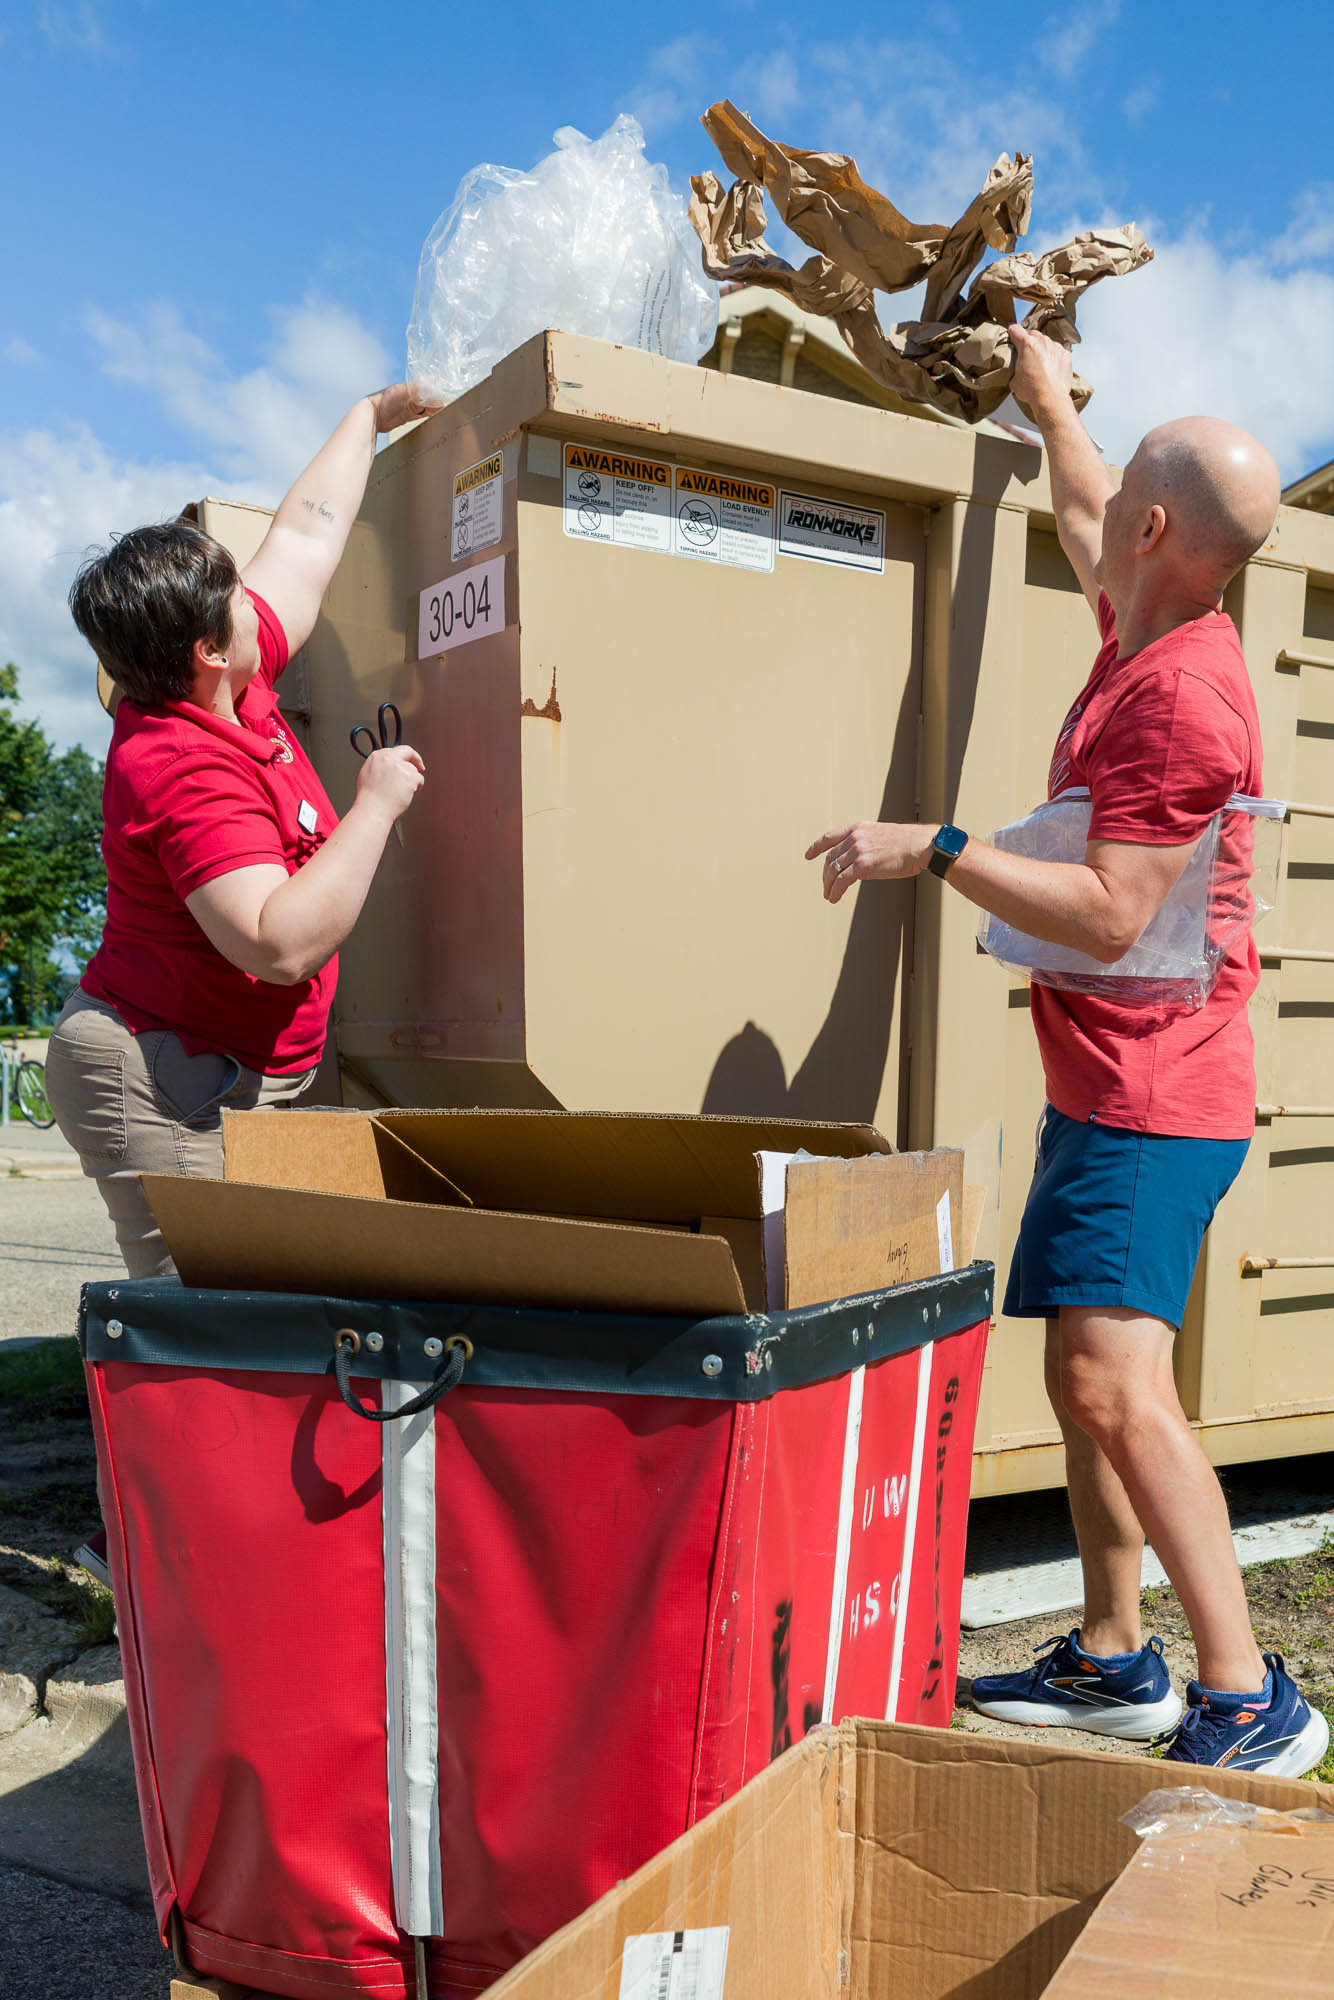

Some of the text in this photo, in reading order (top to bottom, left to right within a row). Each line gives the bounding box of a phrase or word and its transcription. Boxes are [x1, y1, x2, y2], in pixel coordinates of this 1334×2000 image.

[461, 457, 500, 494] WARNING
[583, 452, 667, 484] WARNING
[615, 479, 654, 493] KEEP OFF!
[693, 474, 770, 505] WARNING
[569, 494, 611, 507] FALLING HAZARD
[722, 500, 770, 518] LOAD EVENLY!
[790, 501, 878, 525] POYNETTE
[569, 527, 590, 537] FALLING
[590, 531, 611, 540] HAZARD
[787, 509, 876, 548] IRONWORKS
[680, 546, 698, 554] TIPPING
[430, 575, 491, 642] 30-04
[1219, 1746, 1239, 1768] BROOKS
